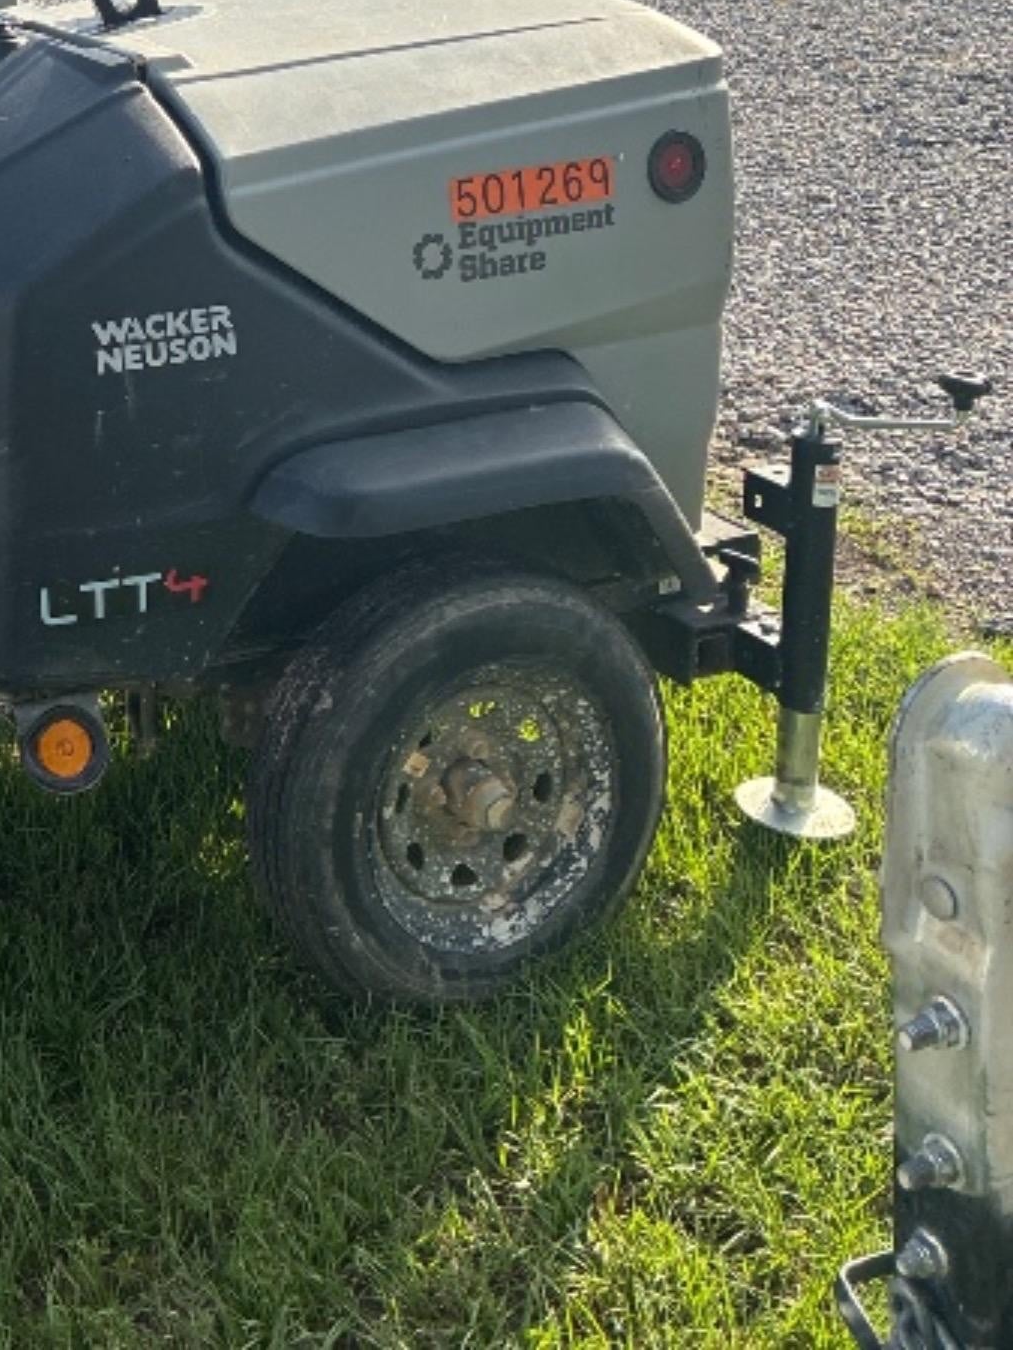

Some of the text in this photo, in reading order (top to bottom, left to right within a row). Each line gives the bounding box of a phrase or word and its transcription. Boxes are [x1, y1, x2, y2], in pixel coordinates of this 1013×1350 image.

[457, 158, 610, 217] 501269
[458, 203, 616, 251] Equipment
[459, 250, 547, 282] Share
[91, 305, 234, 346] WACKER
[97, 329, 237, 376] NEUSON
[40, 568, 208, 626] LTT4
